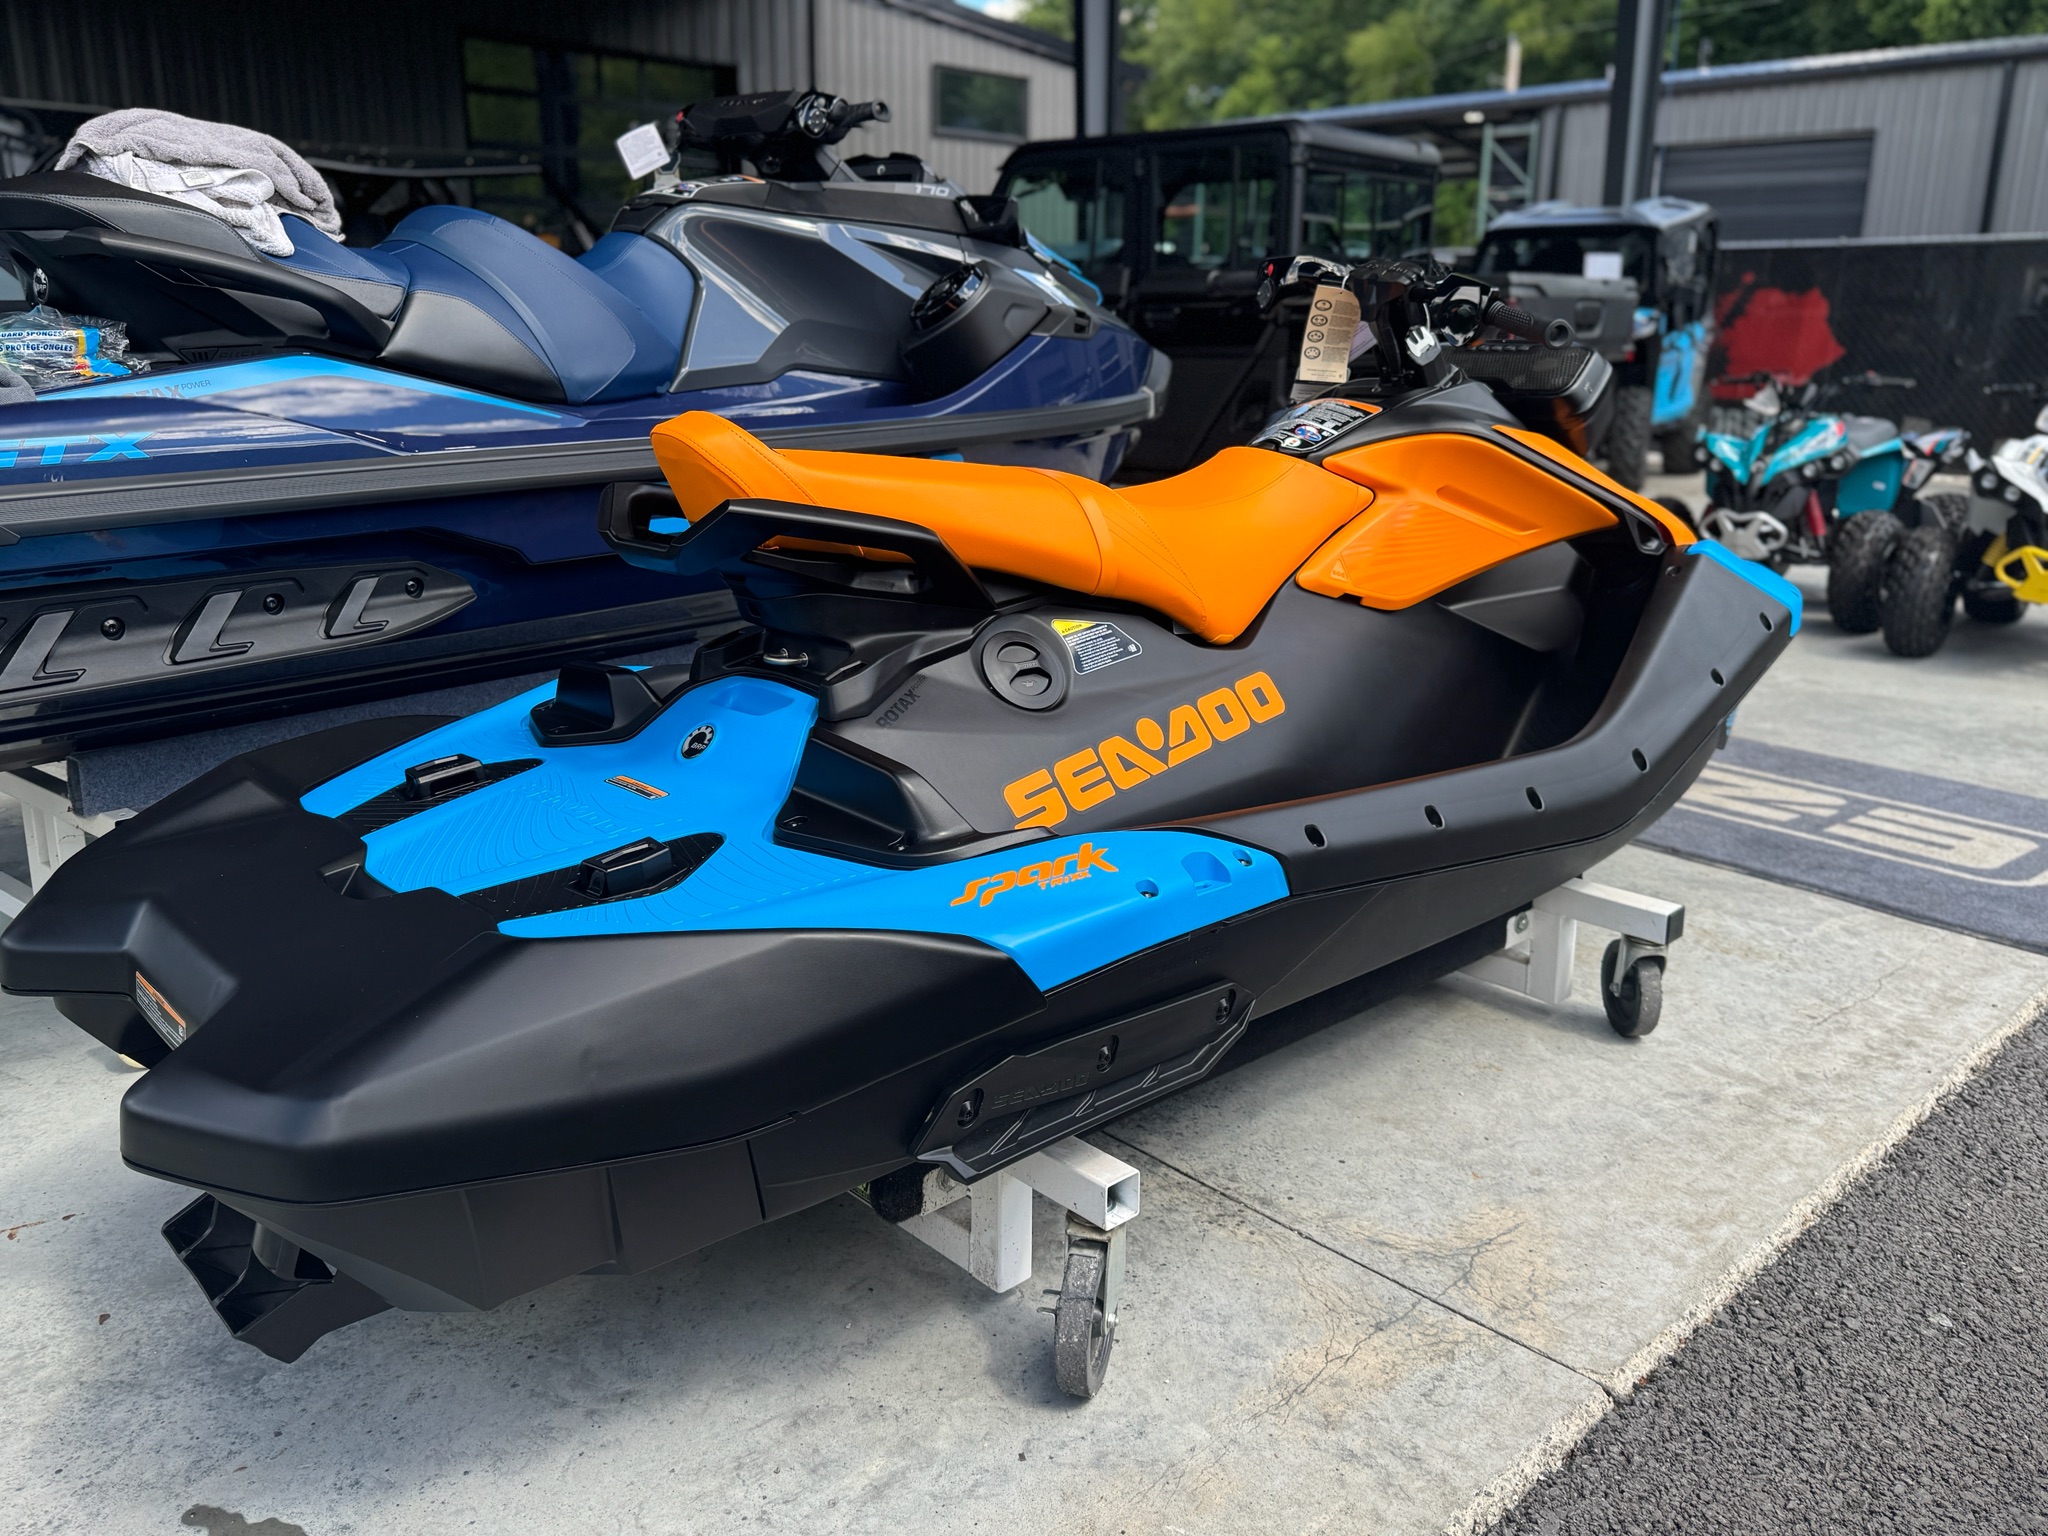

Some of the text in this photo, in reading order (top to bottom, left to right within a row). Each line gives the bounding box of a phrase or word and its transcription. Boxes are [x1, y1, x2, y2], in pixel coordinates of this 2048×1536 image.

[915, 184, 950, 197] 170
[181, 380, 211, 390] POWER
[875, 688, 921, 728] ROTAX
[690, 742, 707, 750] BRP
